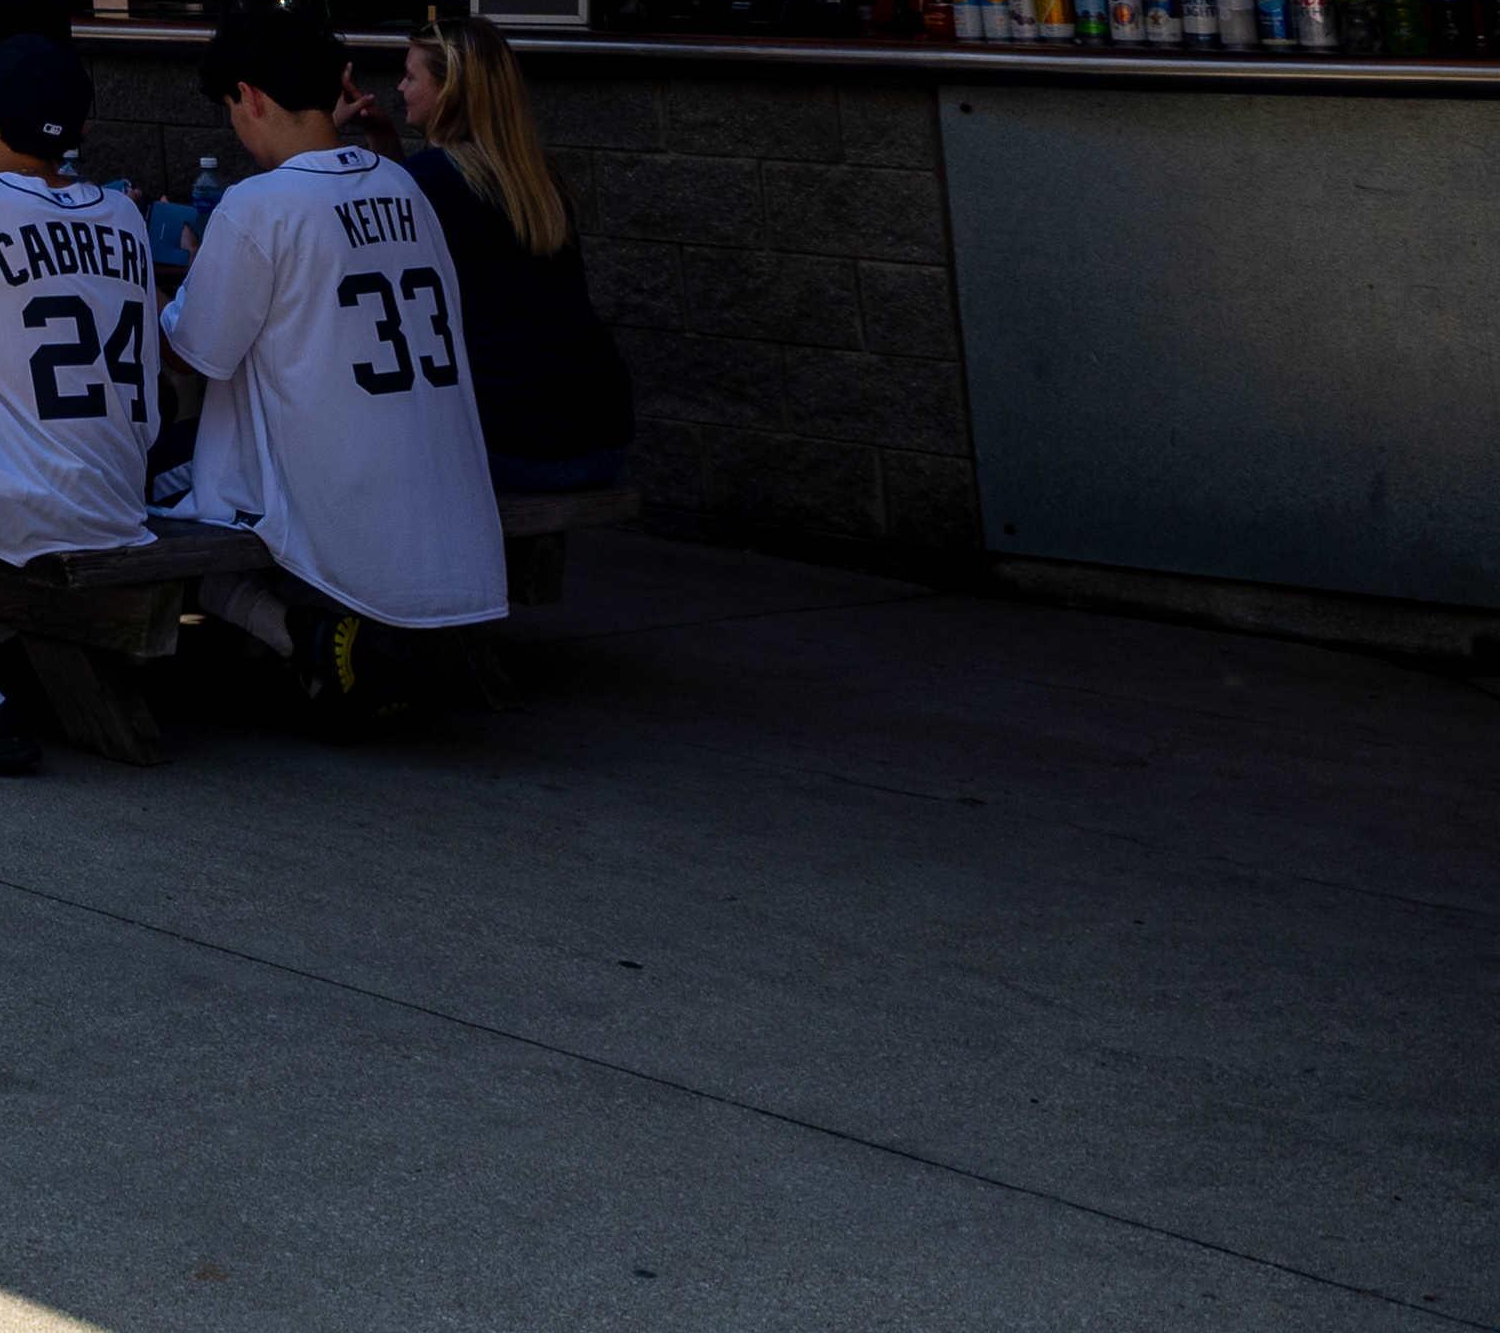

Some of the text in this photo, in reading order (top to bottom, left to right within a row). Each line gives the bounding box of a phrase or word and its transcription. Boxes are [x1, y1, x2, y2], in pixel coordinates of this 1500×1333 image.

[335, 196, 418, 249] KEITH
[21, 294, 149, 423] 24
[337, 266, 460, 396] 33
